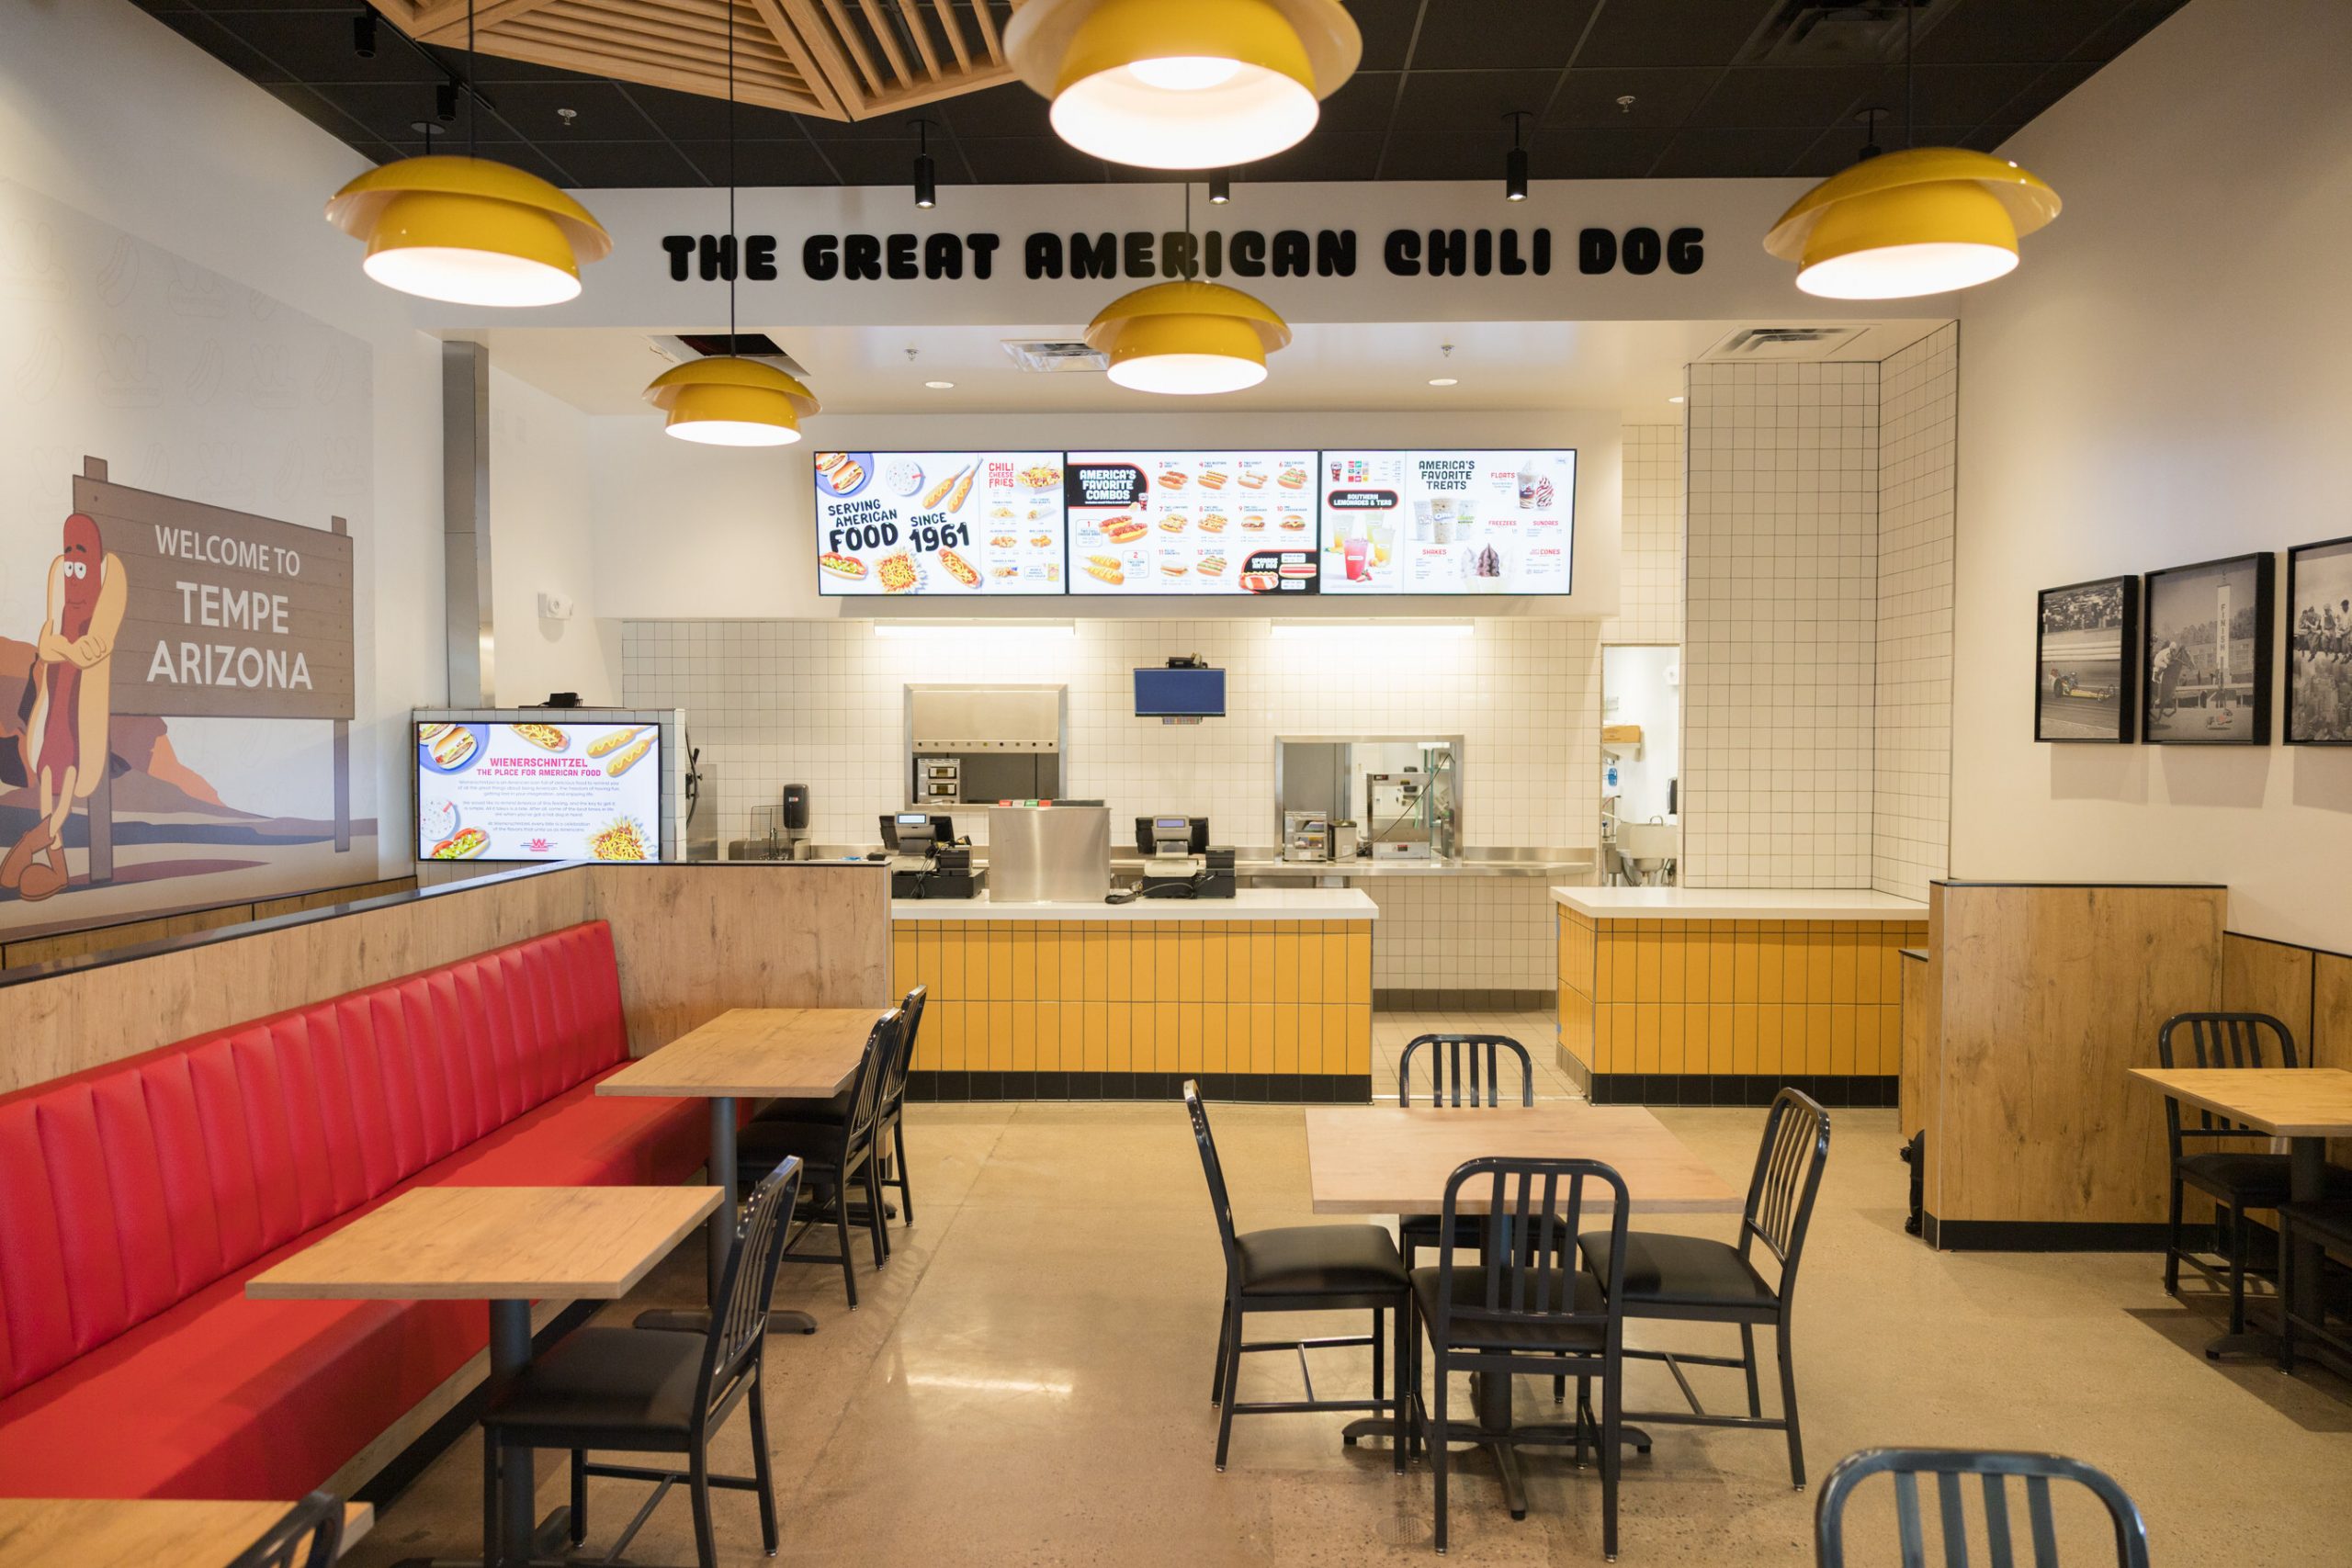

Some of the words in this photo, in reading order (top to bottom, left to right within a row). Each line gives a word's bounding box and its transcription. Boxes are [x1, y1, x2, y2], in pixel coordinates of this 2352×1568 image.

[662, 234, 777, 281] THE
[803, 232, 1001, 281] GREAT
[1024, 229, 1356, 279] AMERICAN
[1384, 227, 1551, 277] CHILI
[1578, 226, 1705, 276] DOG
[989, 463, 1014, 471] CHILI
[1419, 460, 1475, 469] AMERICA'S
[1080, 469, 1136, 479] AMERICA'S
[1421, 471, 1472, 480] FAVORITE
[989, 478, 1014, 488] FRIES
[1082, 480, 1134, 490] FAVORITE
[1426, 480, 1467, 490] TREATS
[1086, 490, 1130, 500] COMBOS
[828, 499, 881, 516] SERVING
[836, 509, 897, 528] AMERICAN
[910, 513, 947, 527] SINCE
[829, 522, 899, 553] FOOD
[909, 522, 969, 553] 1961
[155, 525, 269, 572] WELCOME
[274, 548, 300, 577] TO
[176, 581, 289, 634] TEMPE
[146, 640, 313, 690] ARIZONA
[490, 758, 588, 767] WIENERSCHNITZEL
